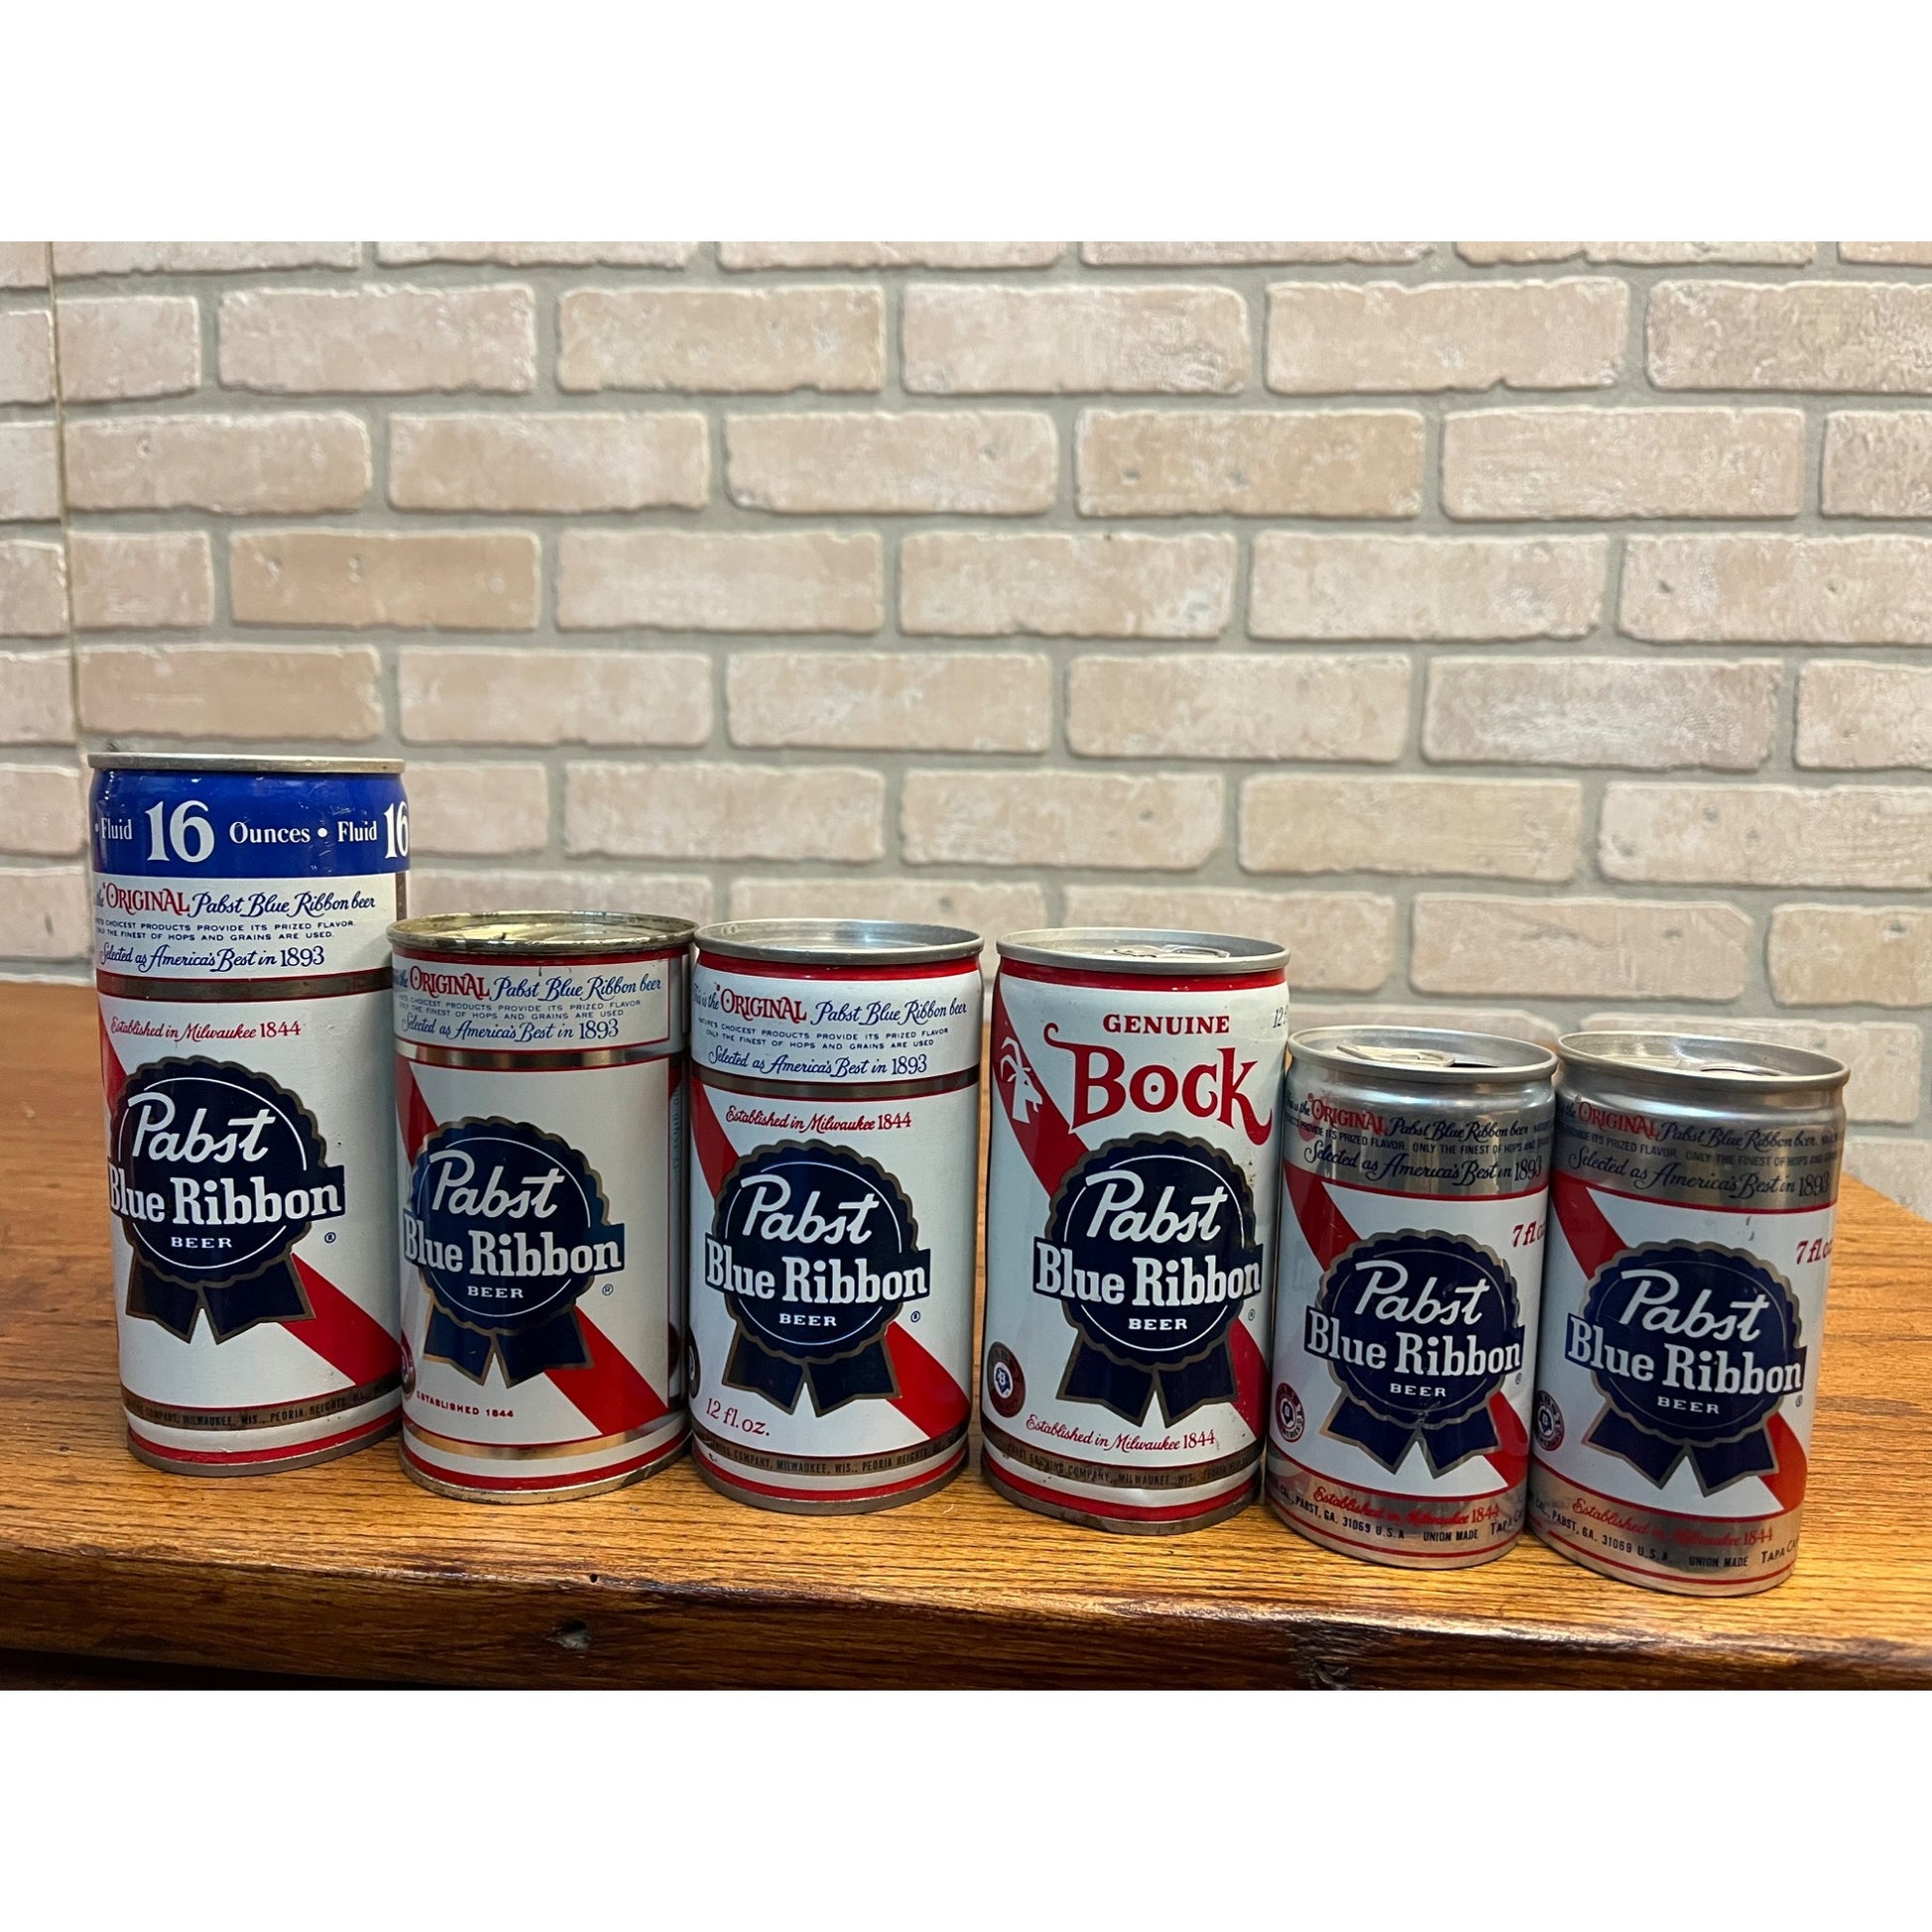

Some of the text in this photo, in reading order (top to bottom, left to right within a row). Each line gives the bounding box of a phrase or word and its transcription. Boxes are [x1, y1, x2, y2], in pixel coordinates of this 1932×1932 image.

[100, 799, 408, 862] Fluid 16 Ounces Fluid 16
[105, 883, 190, 915] ORIGINAL
[188, 892, 245, 917] Pabst
[239, 892, 290, 917] Blue
[286, 891, 348, 917] Ribbon
[351, 891, 375, 908] beer
[100, 942, 325, 973] Selected America's Best in 1893
[410, 965, 661, 1001] ORIGINAL Pabst Blue Ribbon beer
[426, 1008, 450, 1017] FINEST
[721, 988, 967, 1026] ORIGINAL Pabst Blue Ribbon beer
[111, 1017, 302, 1041] Established in Milwaukee 1844
[402, 1013, 619, 1042] Selected America's Best in 1893
[721, 1024, 756, 1035] CHOICEST
[761, 1030, 810, 1038] PRODUCTS
[723, 1033, 734, 1041] THE
[740, 1036, 766, 1045] FINEST
[1102, 1014, 1230, 1035] GENUINE
[708, 1044, 927, 1078] Selected America's Best in 1893
[128, 1092, 276, 1164] Pabst
[726, 1105, 911, 1134] Established in Milwaukee 1844
[1311, 1099, 1389, 1136] ORIGINAL
[1386, 1116, 1430, 1136] Pabst
[1426, 1121, 1464, 1141] Blue
[1459, 1121, 1508, 1143] Ribbon
[1510, 1121, 1529, 1137] beer
[1579, 1102, 1660, 1141] ORIGINAL
[1656, 1121, 1705, 1142] Pabst
[1700, 1127, 1743, 1149] Blue
[1738, 1128, 1792, 1153] Ribbon
[1339, 1132, 1367, 1146] PRIZED
[1413, 1144, 1436, 1154] ONLY
[1441, 1145, 1455, 1155] THE
[1460, 1145, 1489, 1154] FINEST
[1591, 1134, 1786, 1167] ITS PRIZED OF
[1304, 1140, 1542, 1186] Selected America's Best 1893
[1569, 1146, 1830, 1199] Selected America's Best 1893
[109, 1165, 342, 1225] Blue Ribbon
[429, 1149, 565, 1218] Pabst
[740, 1173, 880, 1245] Pabst
[1085, 1170, 1228, 1244] Pabst
[171, 1236, 232, 1249] BEER
[404, 1211, 621, 1277] Blue Ribbon
[706, 1239, 927, 1305] Blue Ribbon
[1035, 1241, 1262, 1307] Blue Ribbon
[468, 1286, 524, 1299] BEER
[1354, 1260, 1490, 1325] Pabst
[1618, 1269, 1770, 1342] Pabst
[778, 1313, 837, 1326] BEER
[1128, 1318, 1188, 1330] BEER
[1308, 1309, 1521, 1376] Blue Ribbon
[1568, 1316, 1802, 1396] Blue Ribbon
[417, 1390, 514, 1418] ESTABLISHED 1844
[1390, 1383, 1447, 1397] BEER
[1657, 1396, 1720, 1415] BEER
[706, 1398, 721, 1420] 12
[742, 1419, 770, 1436] oz.
[1027, 1414, 1215, 1452] Established in Milwaukee 1844
[862, 1457, 892, 1471] PEORIA
[1342, 1517, 1478, 1541] 31069 UNION MADE
[1471, 1503, 1500, 1523] 1844
[1573, 1497, 1650, 1534] Established
[1743, 1527, 1772, 1546] 1844
[1602, 1535, 1632, 1553] 31069
[1689, 1556, 1719, 1567] UNION
[1725, 1557, 1749, 1567] MADE
